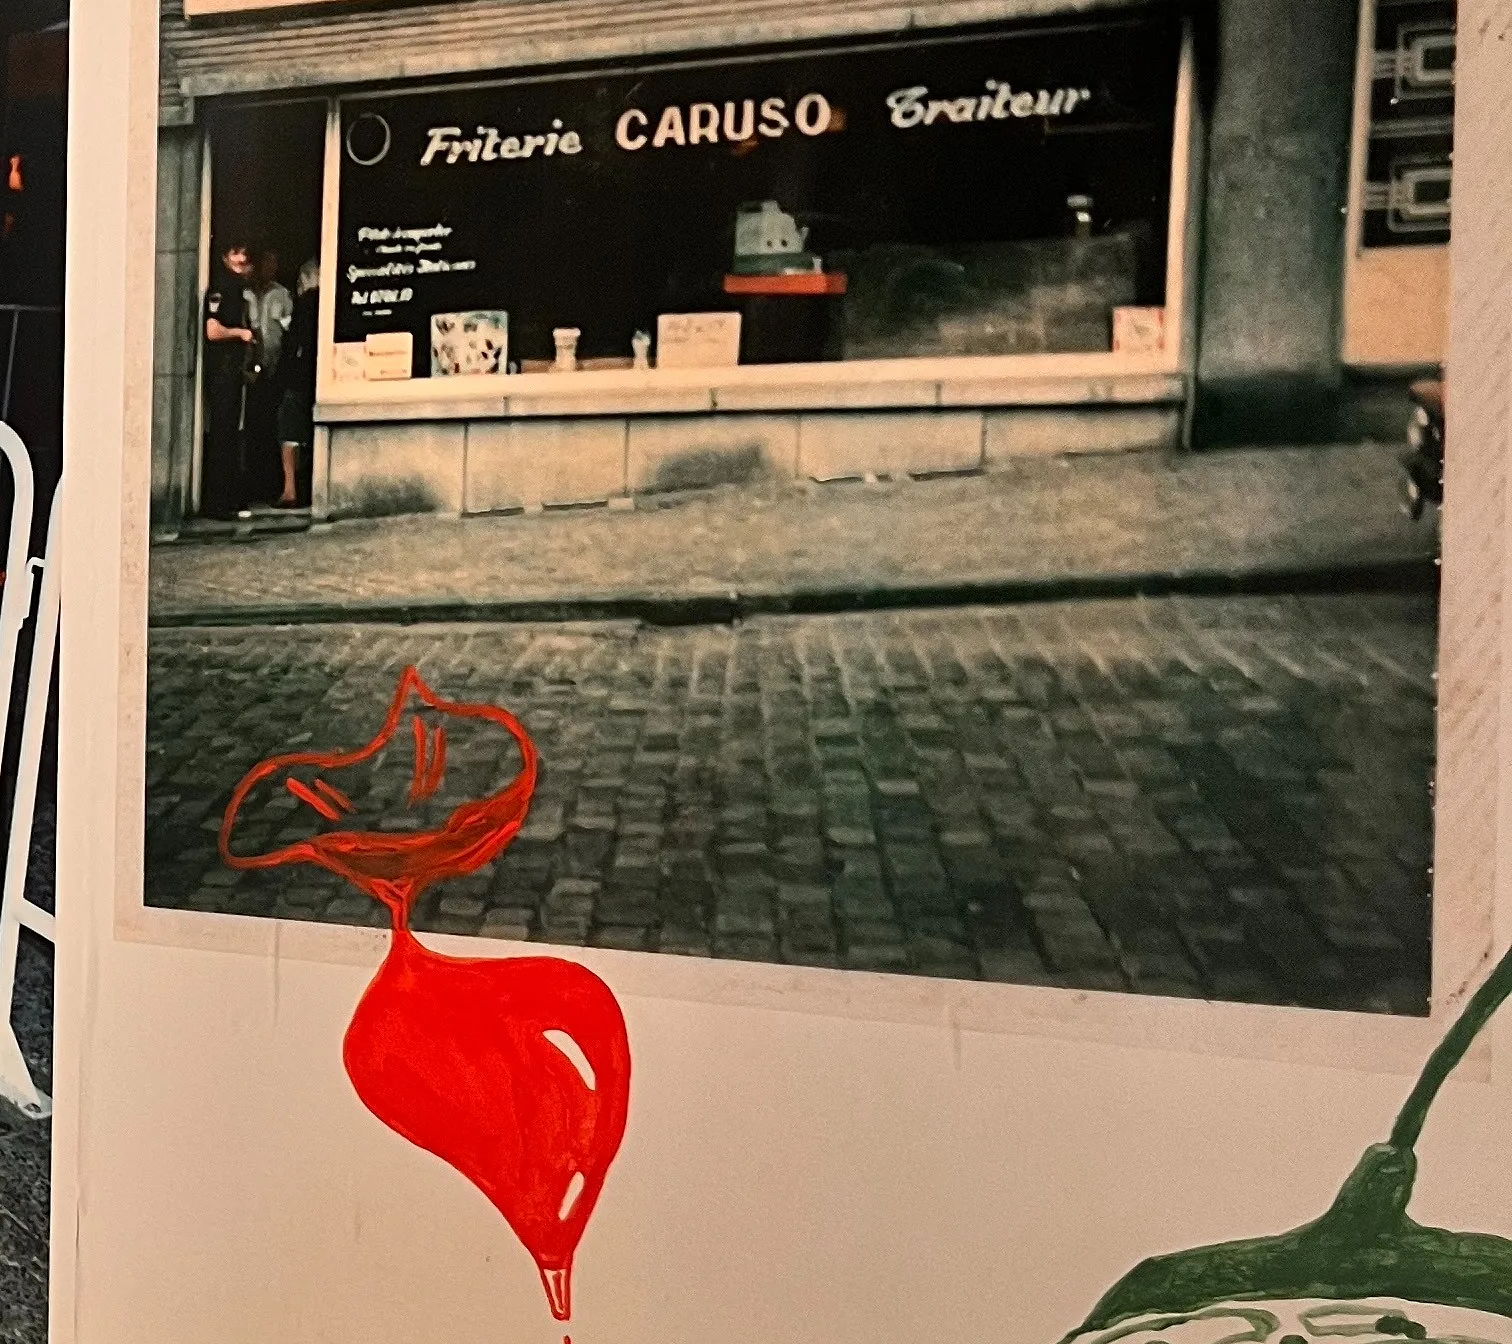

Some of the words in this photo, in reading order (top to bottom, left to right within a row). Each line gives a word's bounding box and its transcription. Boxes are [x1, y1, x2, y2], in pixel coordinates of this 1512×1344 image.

[420, 118, 584, 166] Friterie
[615, 92, 833, 152] CARUSO
[886, 77, 1091, 130] Traiteur
